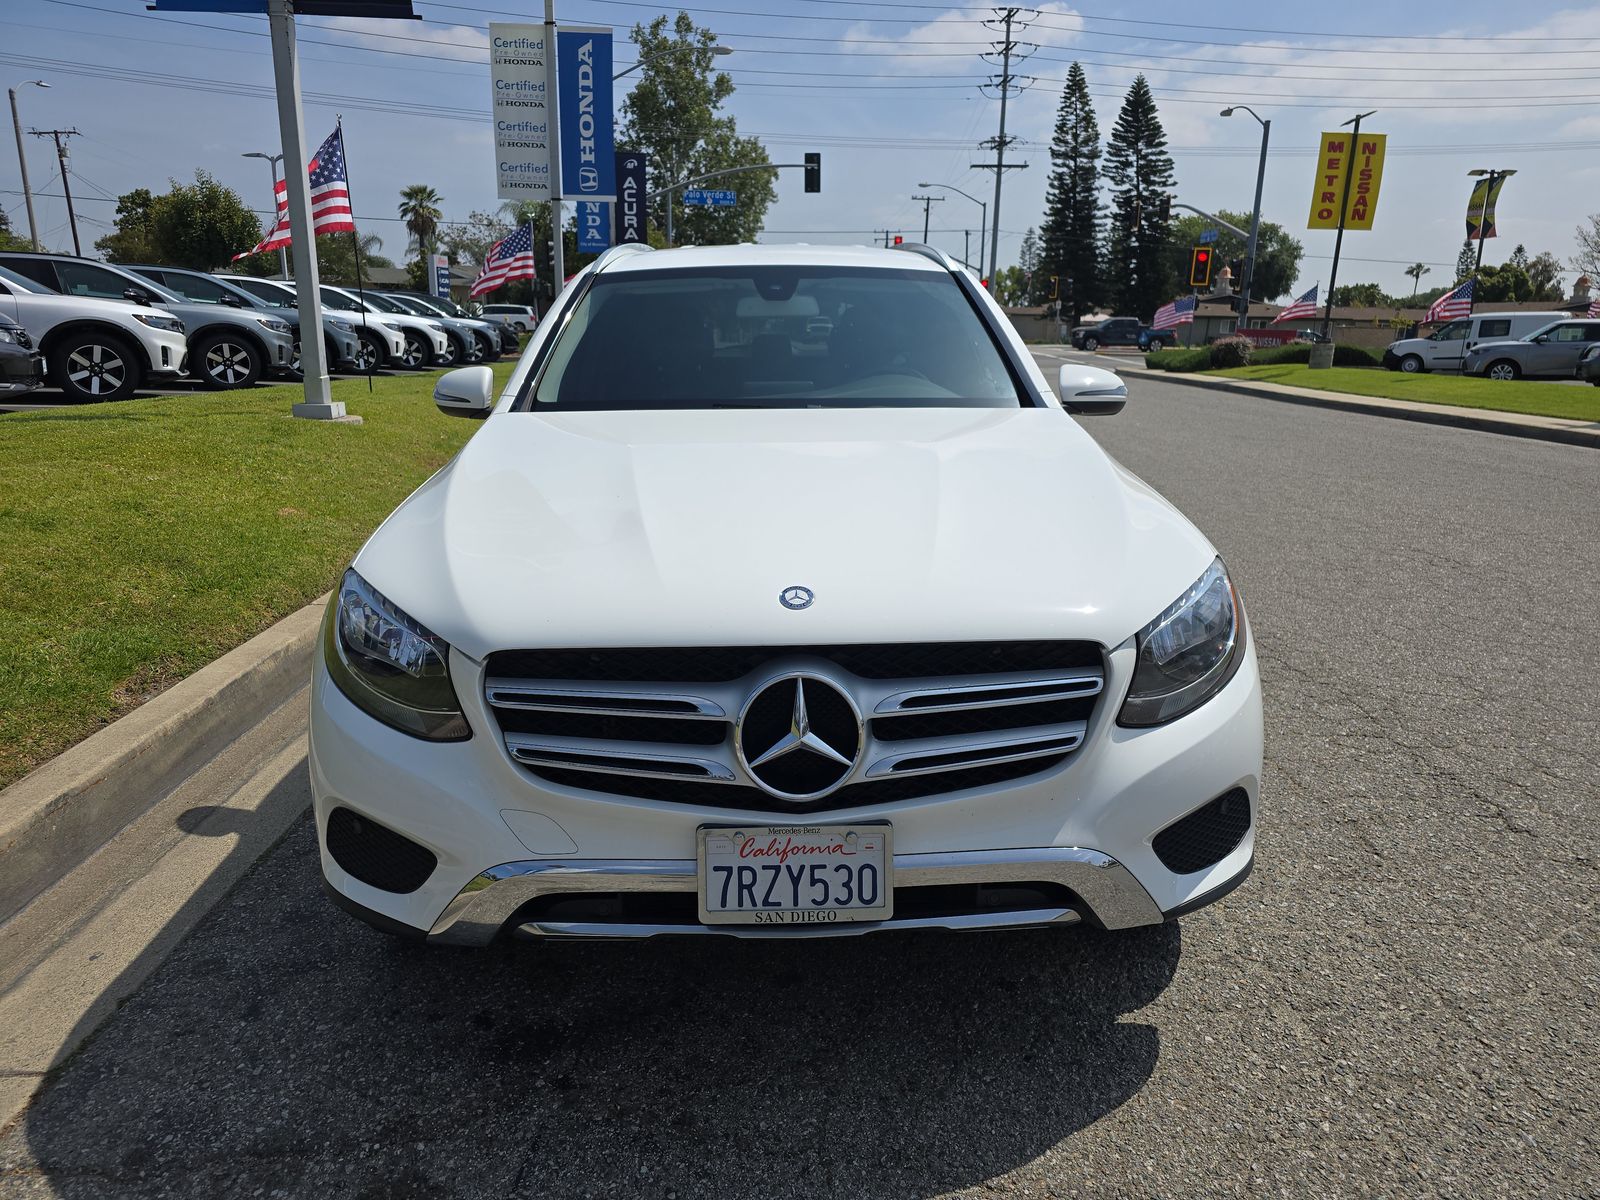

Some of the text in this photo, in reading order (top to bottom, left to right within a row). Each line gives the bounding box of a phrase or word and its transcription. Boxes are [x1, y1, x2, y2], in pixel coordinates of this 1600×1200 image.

[494, 37, 543, 49] Certified
[495, 49, 543, 57] Pre-Owned
[496, 80, 545, 92] Certified
[497, 91, 545, 99] Pre-Owned
[578, 39, 595, 163] HONDA
[498, 121, 546, 133] Certified
[499, 132, 546, 140] Pre-Owned
[500, 162, 548, 174] Certified
[1318, 141, 1344, 219] METRO
[1351, 142, 1376, 221] NISSAN
[703, 190, 724, 198] Verde
[623, 176, 639, 240] ACURA
[585, 202, 602, 240] NDA
[767, 827, 821, 835] Mercedes-Benz
[740, 837, 856, 864] California
[713, 863, 877, 909] 7RZY530
[755, 910, 837, 923] SAN DIEGO
